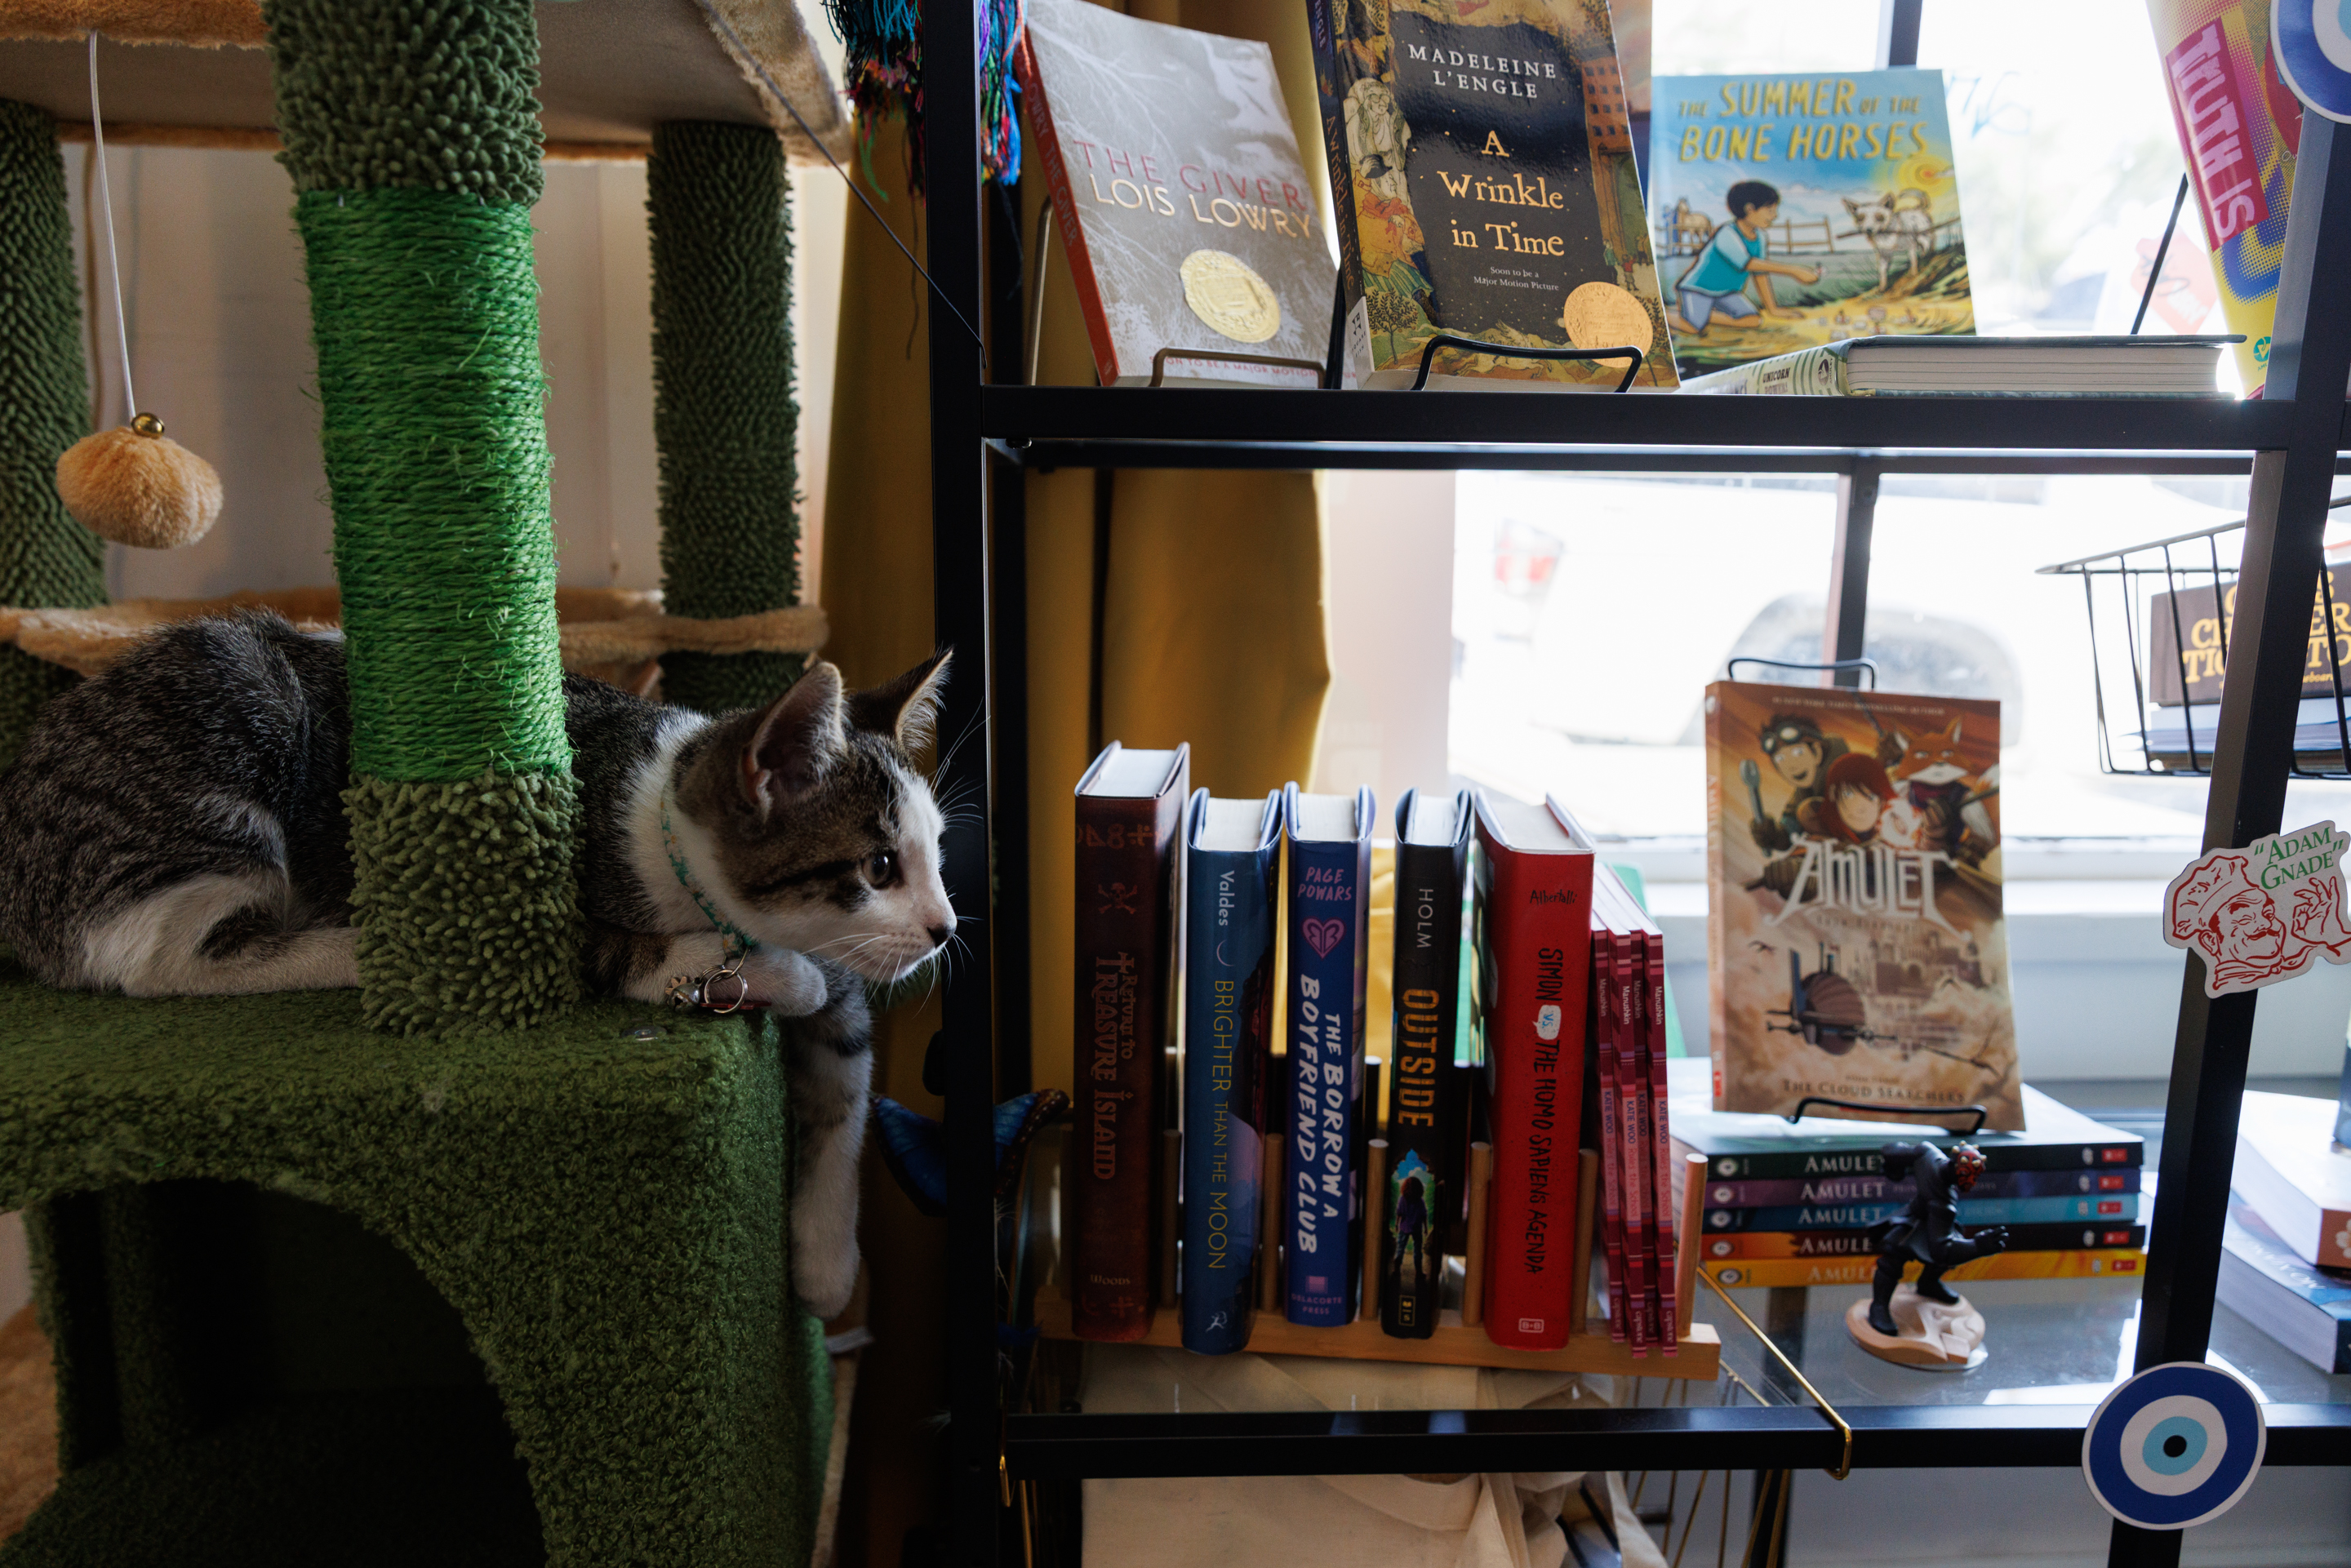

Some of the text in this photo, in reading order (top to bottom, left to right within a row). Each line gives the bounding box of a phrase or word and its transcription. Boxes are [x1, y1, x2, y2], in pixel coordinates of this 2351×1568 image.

[1407, 44, 1556, 78] MADELEINE
[1678, 78, 1922, 118] THE SUMMER OF THE
[1482, 130, 1510, 158] A
[1679, 121, 1930, 162] BONE HORSES
[2171, 23, 2255, 238] TRUTH IS
[1073, 140, 1308, 211] THE GIVER
[1436, 170, 1564, 210] Wrinkle
[1089, 174, 1310, 239] LOIS LOWRY
[1329, 127, 1348, 215] Wrinkle
[1342, 233, 1355, 291] Time
[1451, 219, 1565, 257] in Time
[1473, 276, 1559, 291] Major Motion Picture
[1490, 266, 1511, 276] Soon
[1513, 269, 1522, 278] to
[1522, 269, 1533, 278] be
[1149, 356, 1184, 366] SON
[1762, 367, 1791, 384] UNICORN
[1297, 883, 1353, 901] POWARS
[1305, 866, 1344, 884] PAGE
[1219, 870, 1235, 926] Valdes
[1529, 889, 1578, 905] Albertalli
[1416, 888, 1433, 949] HOLM
[1535, 948, 1563, 1002] SIMON
[1599, 979, 1607, 1017] Manushkin
[1622, 985, 1631, 1025] Manushkin
[1633, 979, 1642, 1019] Manushkin
[1654, 985, 1664, 1025] Manushkin
[1398, 988, 1440, 1127] OUTSIDE
[1534, 1040, 1560, 1073] THE
[1297, 973, 1320, 1254] BOYFRIEND CLUB
[1322, 1013, 1344, 1218] THE BORROW A
[1531, 1078, 1557, 1130] HOMO
[1604, 1091, 1613, 1113] KATIE
[1626, 1100, 1635, 1122] KATIE
[1638, 1093, 1647, 1114] KATIE
[1659, 1100, 1668, 1122] KATIE
[1208, 980, 1233, 1268] BRIGHTER THAN THE MOON
[1605, 1114, 1613, 1135] WOO
[1627, 1124, 1636, 1144] WOO
[1638, 1117, 1647, 1136] WOO
[1660, 1124, 1668, 1144] WOO
[1529, 1135, 1552, 1204] SAPIENS
[1801, 1182, 1886, 1201] AMULET
[1798, 1206, 1884, 1225] AMULET
[1524, 1209, 1547, 1274] AGENDA
[1800, 1237, 1873, 1255] AMULE
[1291, 1293, 1343, 1304] DELACORTE
[1302, 1306, 1330, 1315] PRESS
